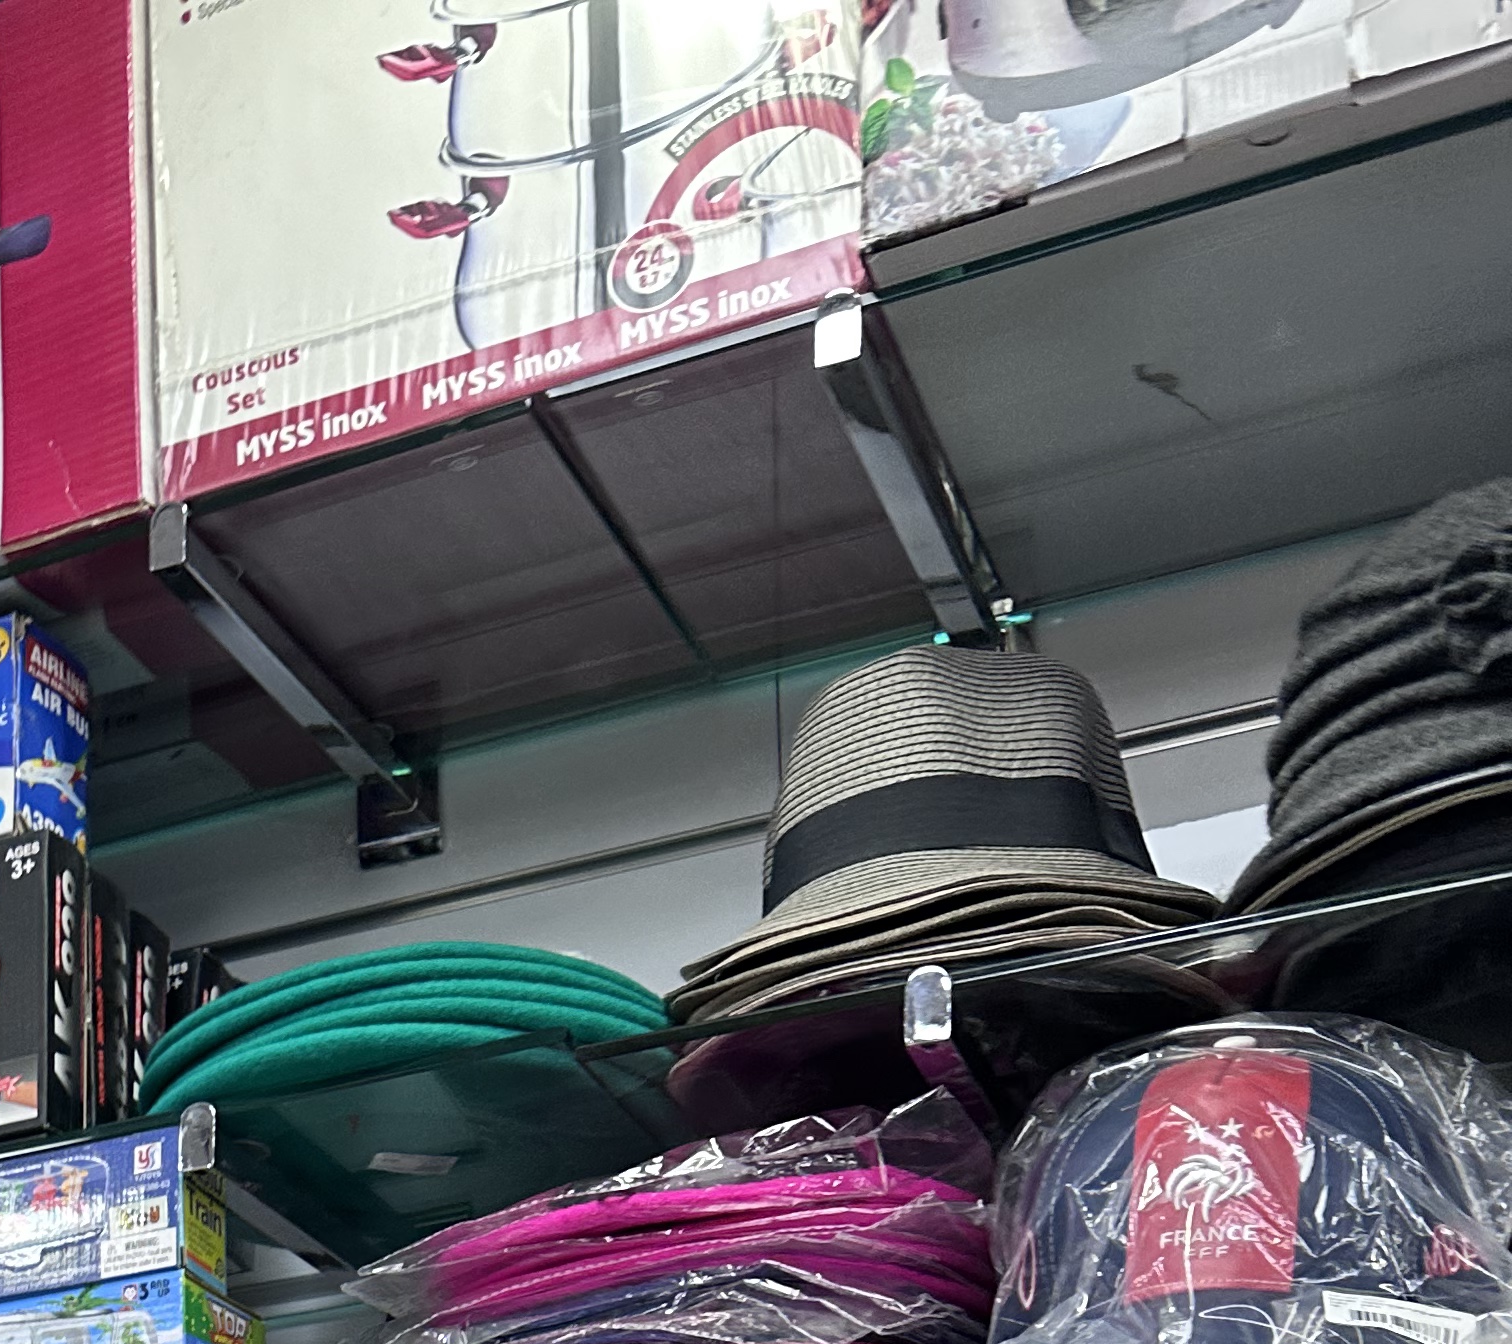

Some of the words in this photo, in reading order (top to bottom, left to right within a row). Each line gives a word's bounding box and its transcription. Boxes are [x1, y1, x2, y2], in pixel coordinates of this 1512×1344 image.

[619, 297, 711, 349] MYSS
[717, 275, 793, 319] inox
[192, 346, 301, 394] Couscous
[422, 360, 506, 410] MYSS
[514, 340, 584, 381] inox
[226, 387, 267, 416] Set
[236, 418, 317, 467] MYSS
[322, 400, 388, 441] inox
[31, 681, 62, 718] AIR
[5, 841, 40, 862] AGES
[11, 860, 36, 881] 3+
[186, 1187, 222, 1238] Train
[1158, 1224, 1261, 1248] FRANCE
[140, 1282, 149, 1300] 3
[150, 1279, 170, 1289] AND
[212, 1302, 246, 1337] TOP
